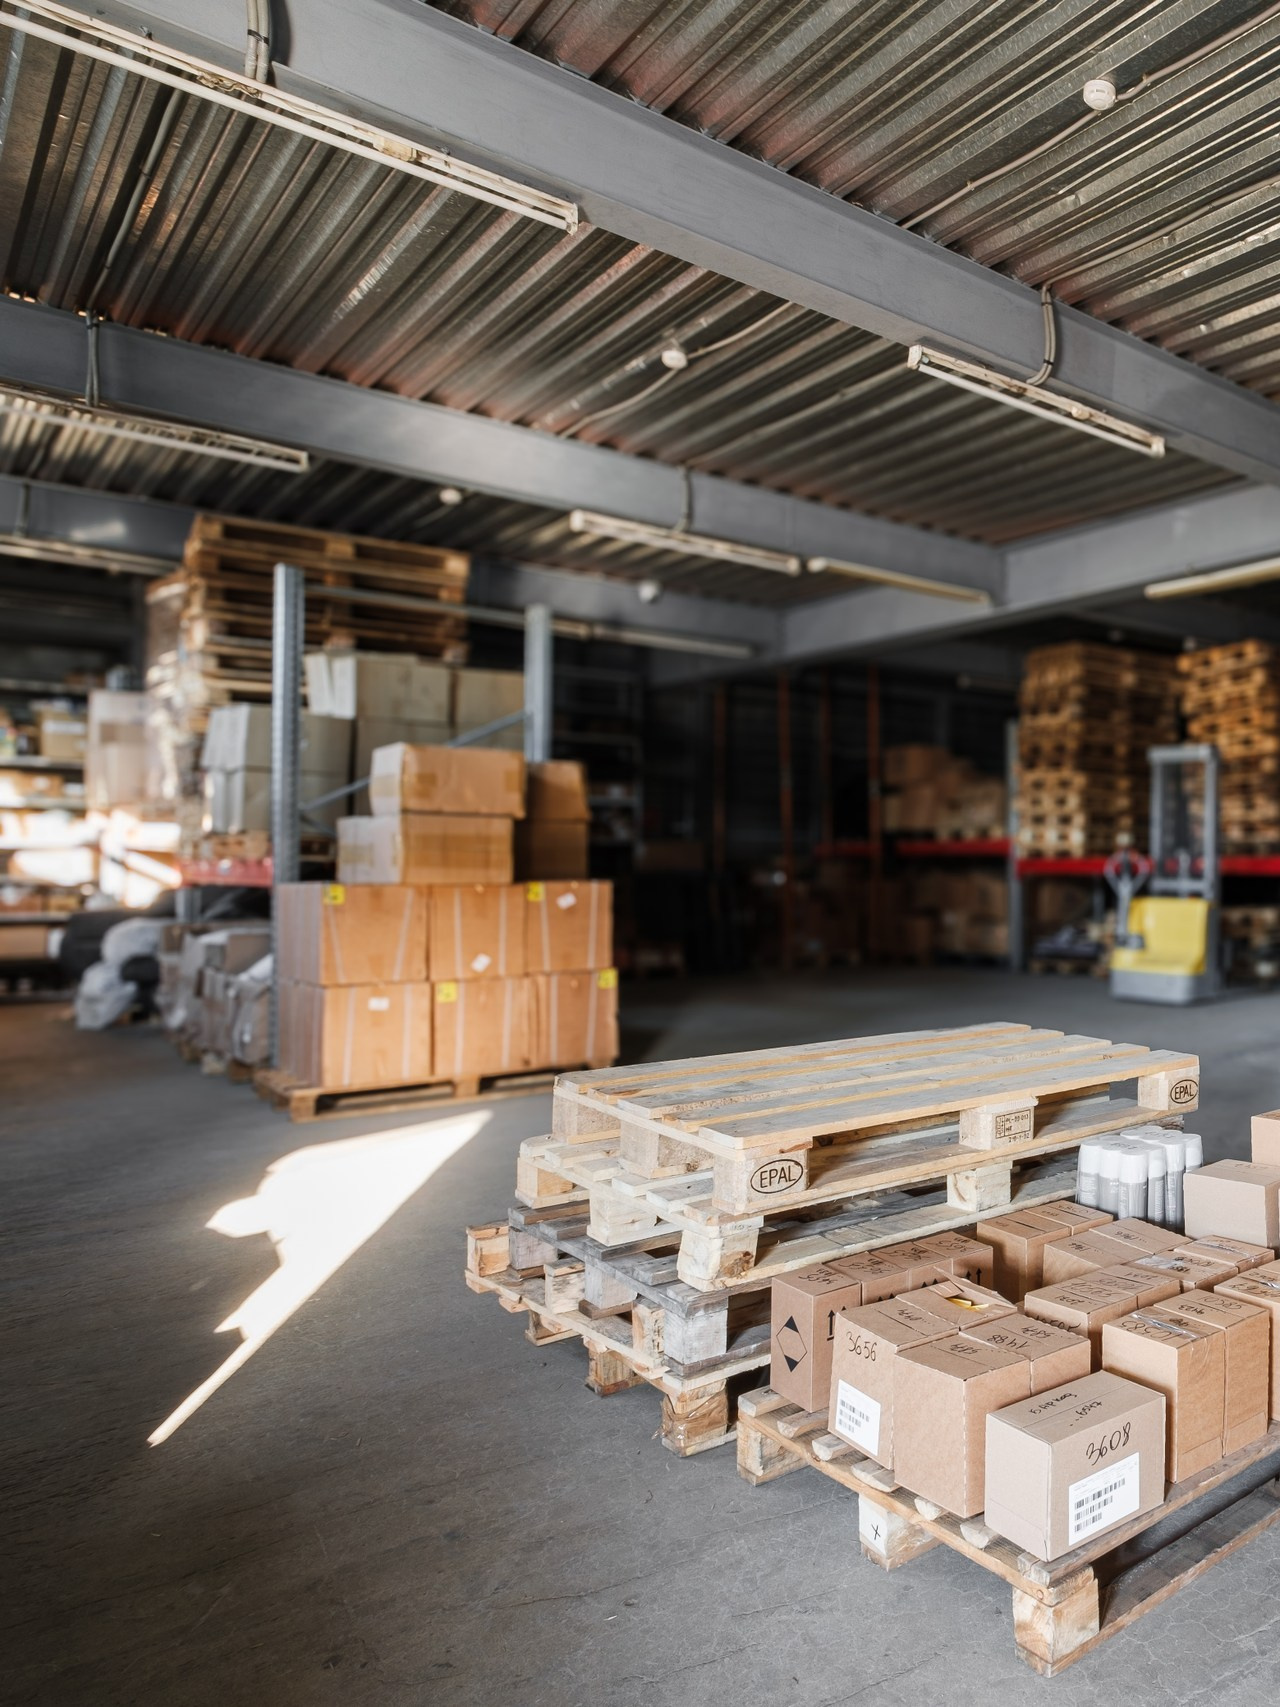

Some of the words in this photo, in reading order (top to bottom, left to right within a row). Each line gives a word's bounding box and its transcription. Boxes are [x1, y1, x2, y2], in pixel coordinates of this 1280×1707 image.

[1174, 1084, 1194, 1100] EPAL
[759, 1165, 797, 1189] EPAL
[986, 1333, 1031, 1351] 1488
[1119, 1320, 1182, 1343] 10585
[846, 1331, 878, 1362] 3656
[1086, 1421, 1131, 1466] 3608
